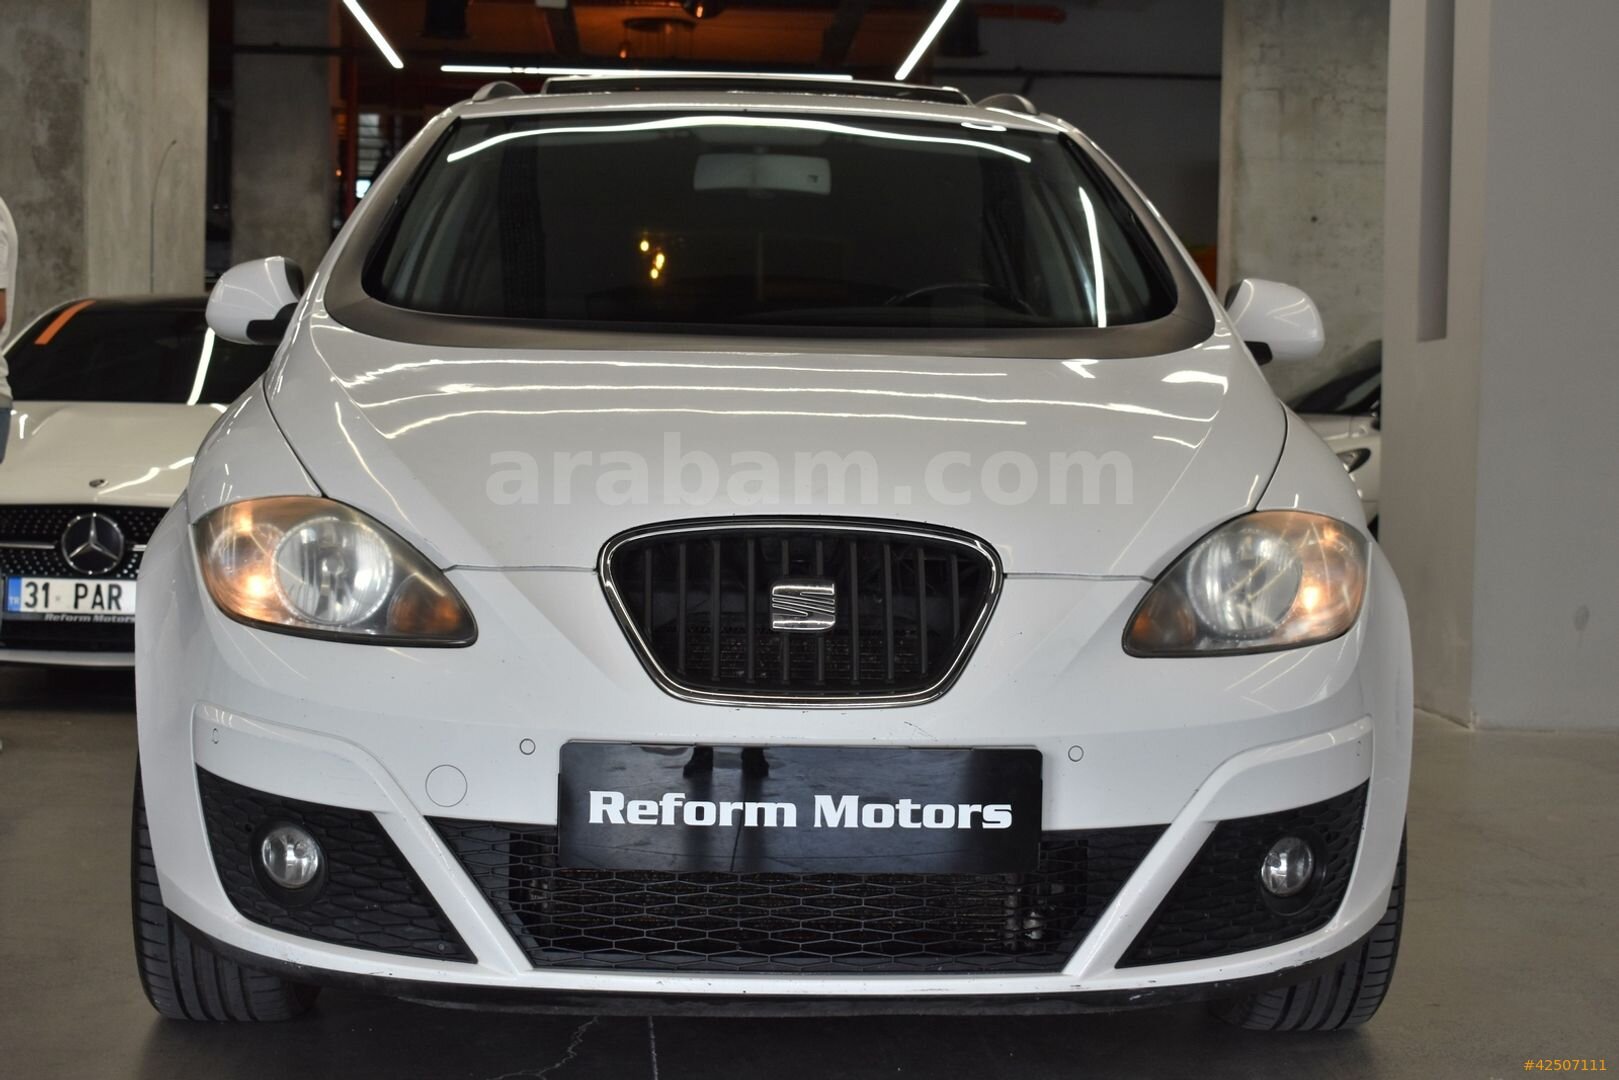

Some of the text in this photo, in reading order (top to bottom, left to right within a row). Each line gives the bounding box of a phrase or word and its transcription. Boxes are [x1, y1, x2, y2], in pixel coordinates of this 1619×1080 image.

[24, 581, 123, 610] 31 PAR
[44, 613, 91, 622] Reform
[588, 790, 1013, 829] Reform Motors
